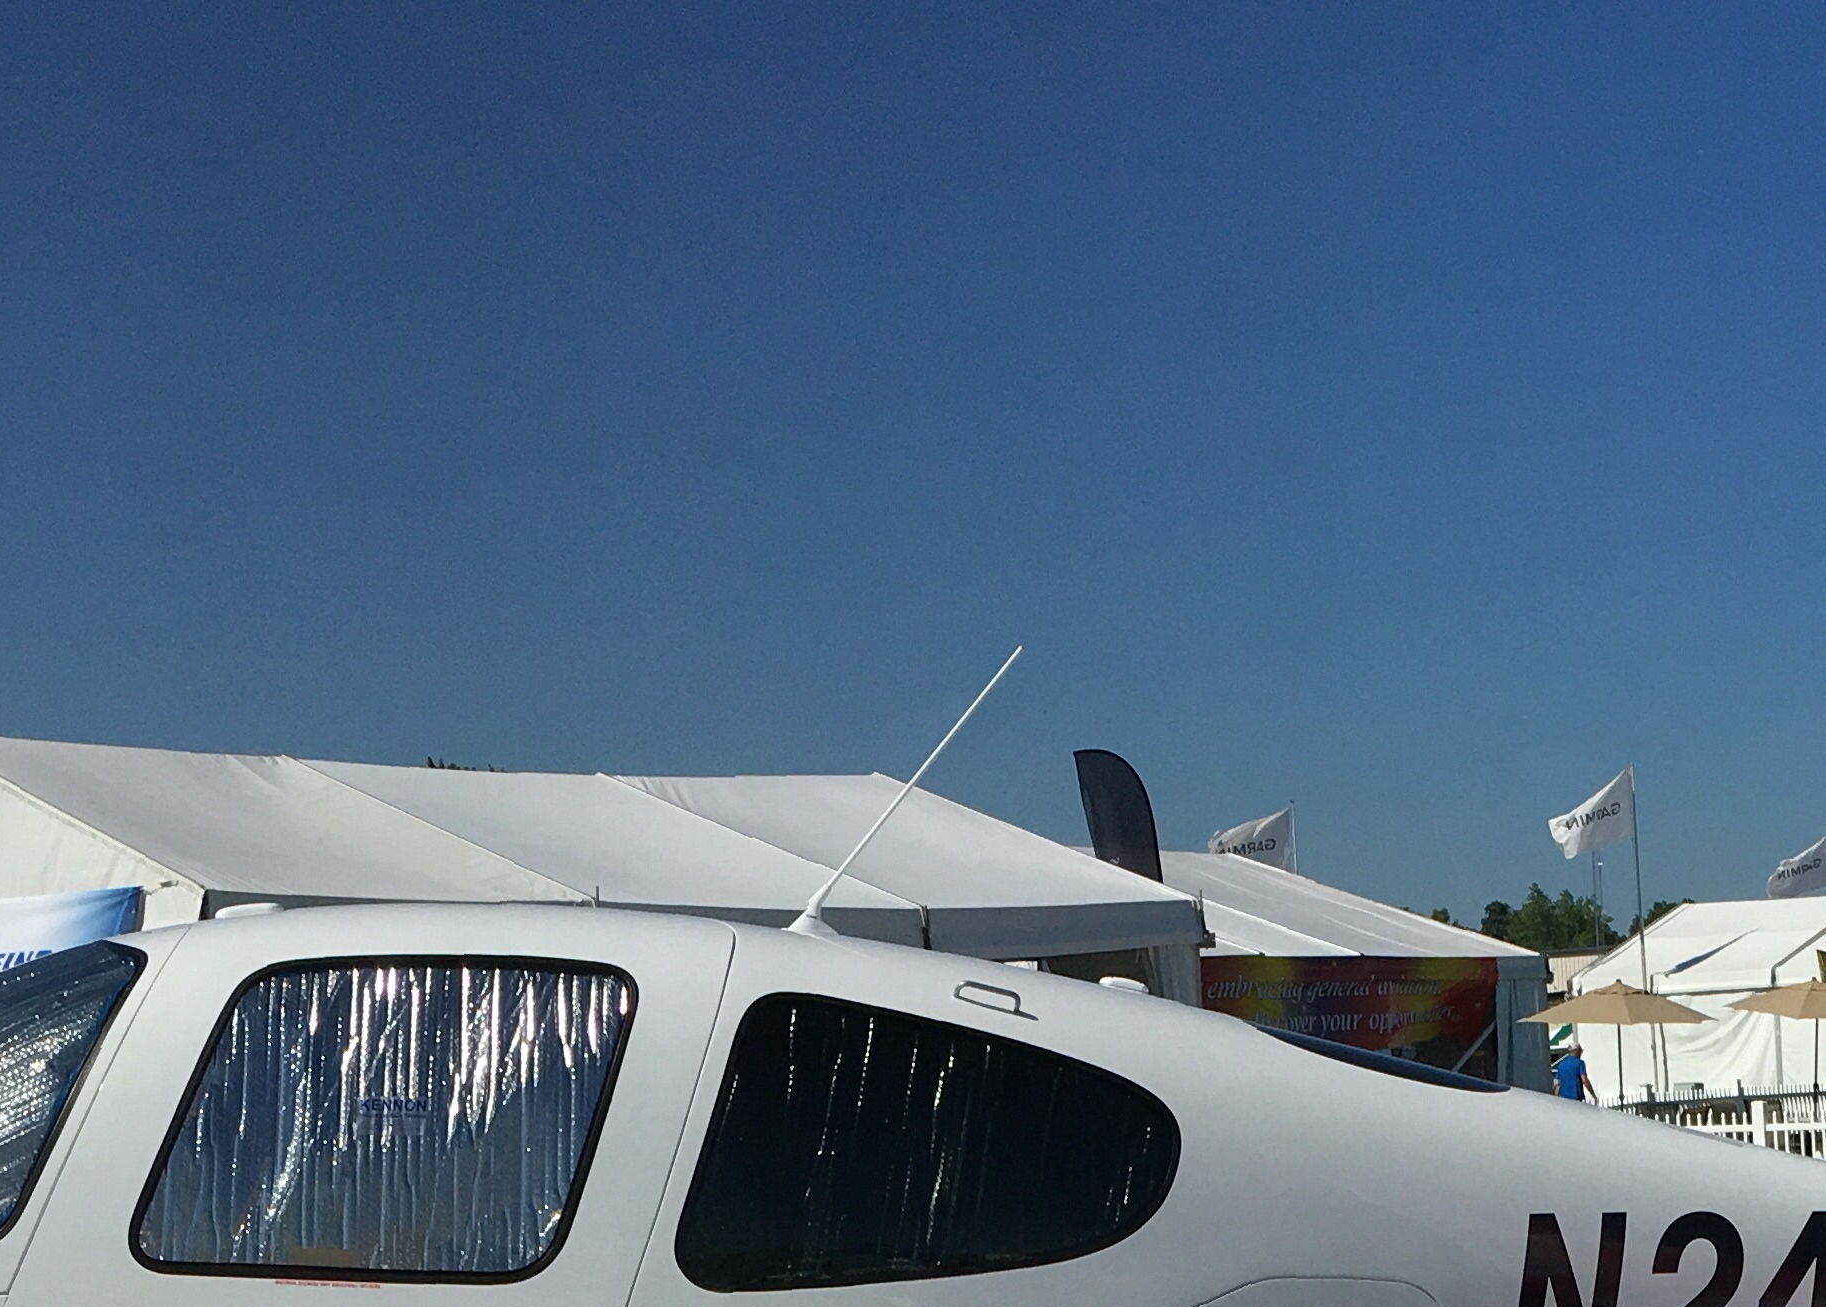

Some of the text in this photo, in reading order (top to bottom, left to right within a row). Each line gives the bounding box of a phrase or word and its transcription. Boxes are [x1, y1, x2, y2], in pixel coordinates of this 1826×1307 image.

[1207, 974, 1303, 1003] embracing
[1306, 974, 1375, 1003] general
[1320, 1012, 1361, 1038] your
[360, 1098, 427, 1112] KENNON
